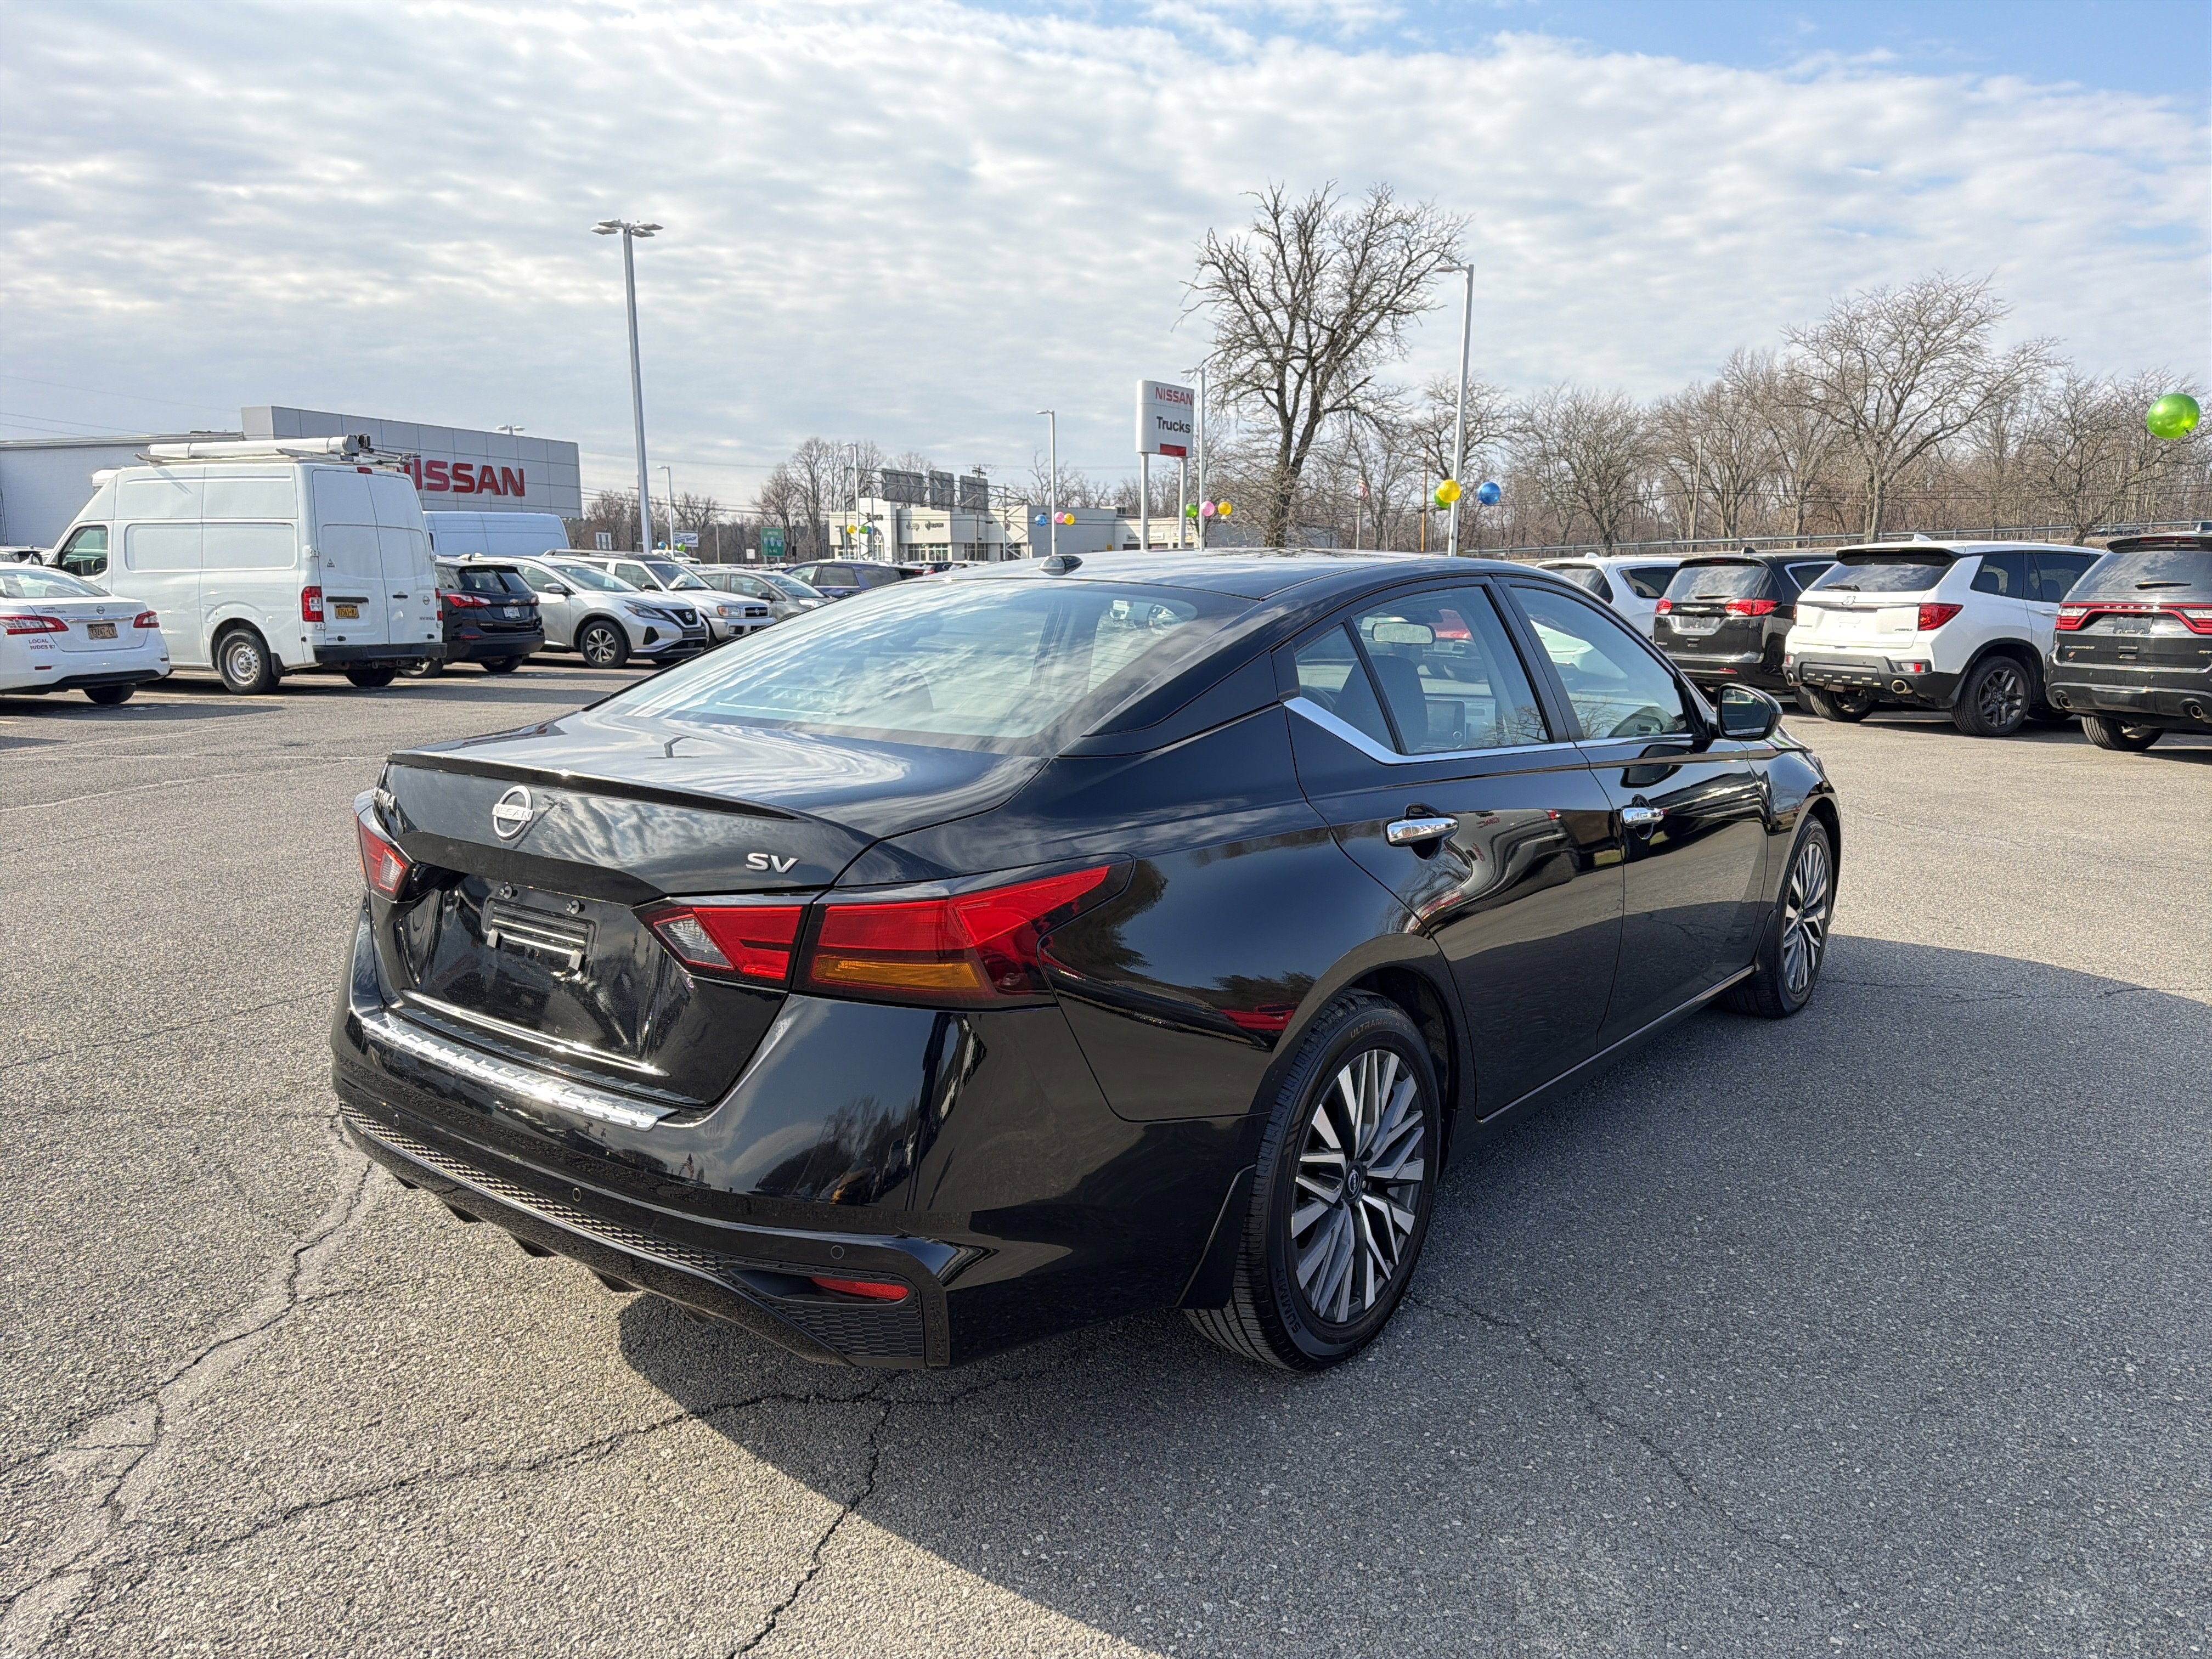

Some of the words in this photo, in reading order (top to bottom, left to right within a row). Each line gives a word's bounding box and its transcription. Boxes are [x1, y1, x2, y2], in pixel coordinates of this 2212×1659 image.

[1155, 386, 1193, 406] NISSAN
[1156, 416, 1190, 433] Trucks
[397, 458, 526, 497] ISSAN
[373, 786, 396, 810] LTIMA
[495, 805, 532, 820] NISSAN
[745, 853, 799, 873] SV
[1349, 1018, 1393, 1039] ULTRAMAX
[1275, 1267, 1301, 1334] SUMMIT
